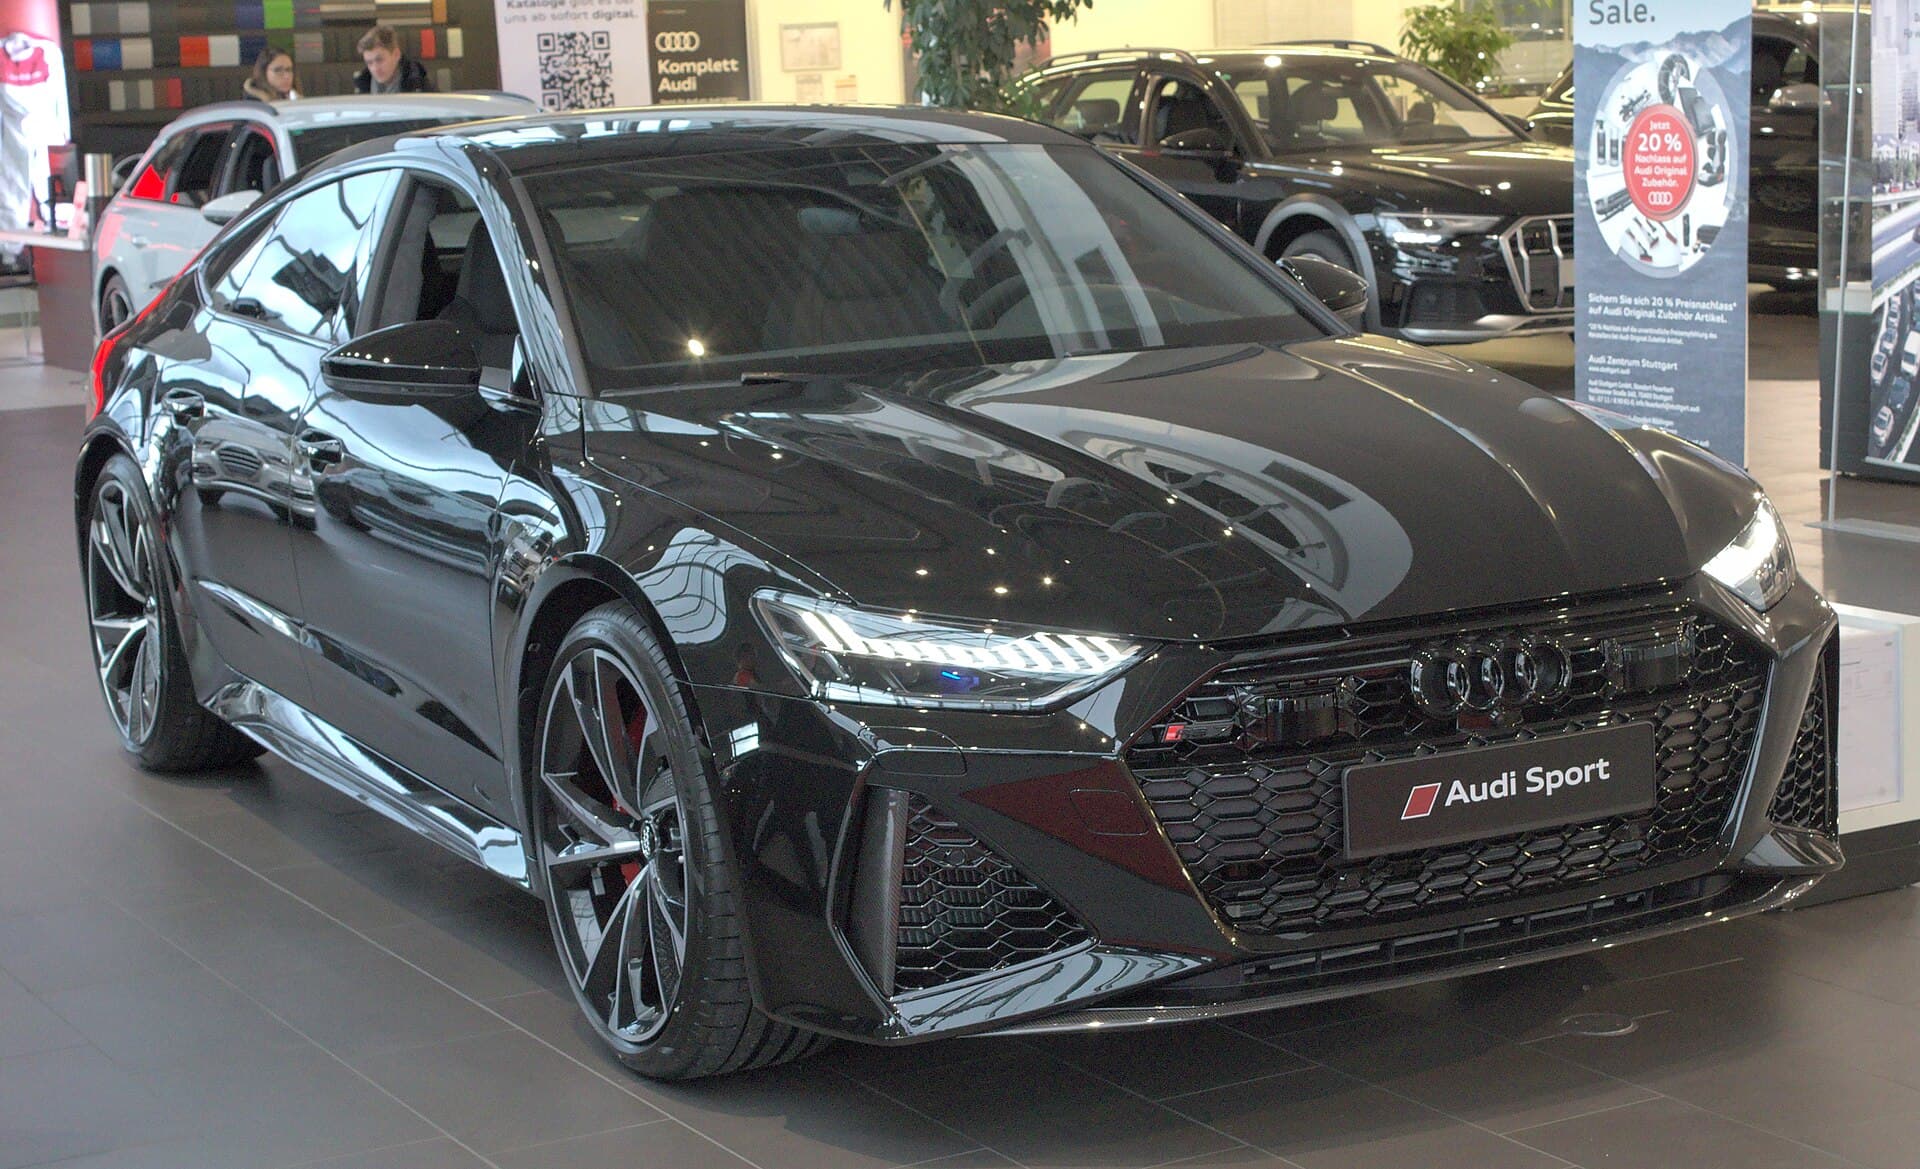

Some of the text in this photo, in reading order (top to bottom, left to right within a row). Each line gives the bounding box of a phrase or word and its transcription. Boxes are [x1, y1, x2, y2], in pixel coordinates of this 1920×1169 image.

[504, 9, 639, 24] uns ab sofort digital.
[1589, 0, 1656, 25] Sale.
[657, 58, 739, 76] Komplett
[658, 76, 697, 92] Audi
[1649, 120, 1670, 132] Jetzt
[1638, 133, 1683, 152] 20 %
[1634, 154, 1687, 164] Nachlass auf
[1634, 165, 1688, 177] Audi Original
[1588, 292, 1618, 304] Sichern
[1619, 294, 1632, 305] Sie
[1633, 295, 1650, 306] sich
[1651, 296, 1663, 307] 20
[1665, 297, 1674, 308] %
[1588, 305, 1728, 324] auf Audi Original Zubehör Artikel.
[1588, 354, 1678, 371] Audi Zentrum Stuttgart
[1444, 757, 1610, 807] Audi Sport
